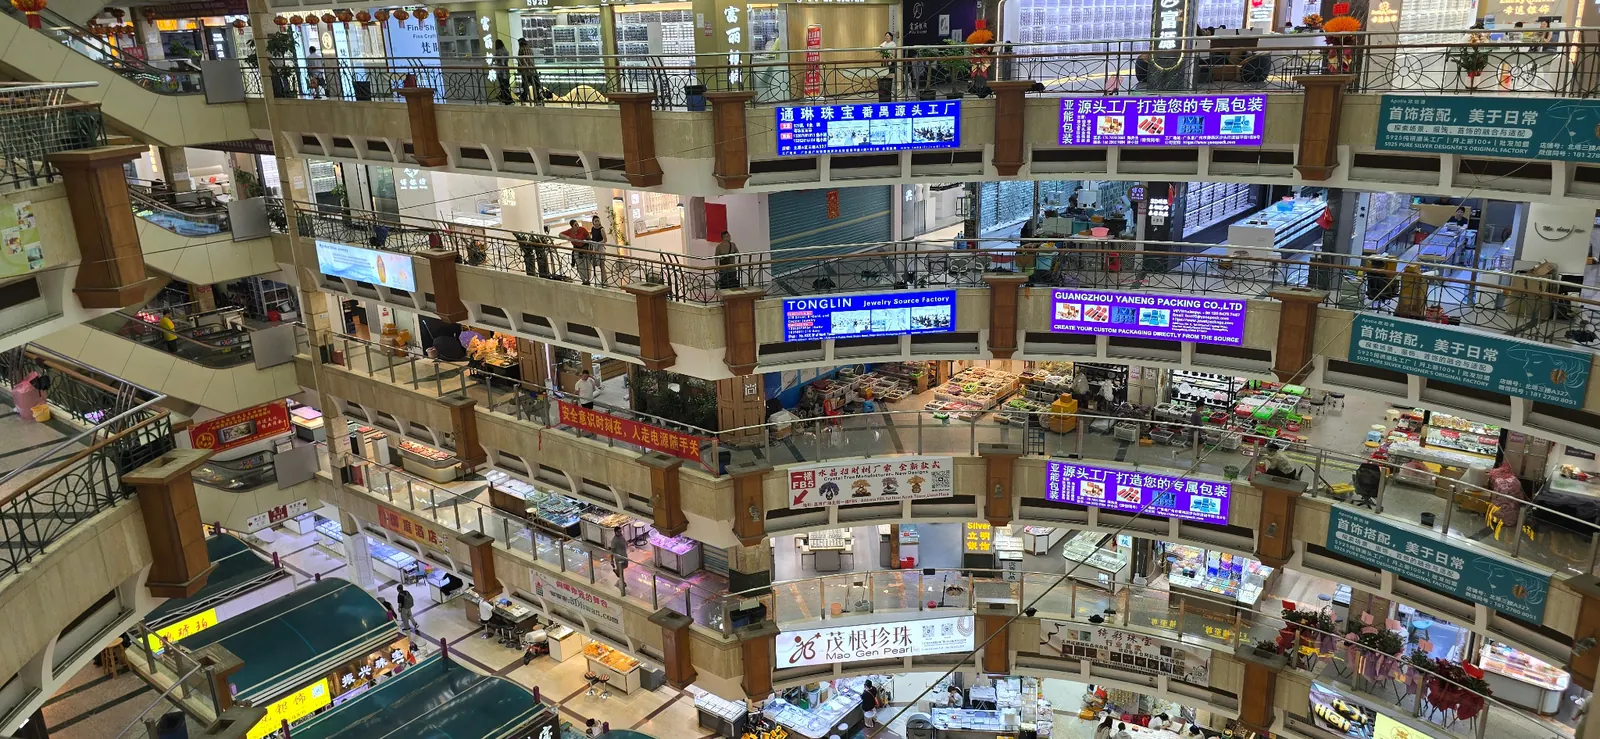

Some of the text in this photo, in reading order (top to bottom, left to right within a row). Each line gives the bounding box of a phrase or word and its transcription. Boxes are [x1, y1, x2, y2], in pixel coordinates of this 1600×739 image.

[780, 102, 955, 122] 通琳珠宝番禺源头工厂
[1077, 97, 1263, 115] 源头工厂打造您的专属包装
[1062, 100, 1074, 145] 亚能包装
[1389, 107, 1539, 126] 首饰搭配，美于日常
[788, 298, 852, 310] TONGLIN
[864, 300, 890, 308] Jewelry
[922, 296, 950, 304] Factory
[1055, 292, 1242, 311] GUANGZHOU YANENG PACKING CO.,LTD
[1360, 324, 1498, 362] 首饰搭配，美于日常
[1434, 371, 1462, 381] ORIGINAL
[1462, 377, 1489, 387] FACTORY
[1560, 398, 1577, 406] 8051
[562, 405, 699, 457] 安全意识时刻在，人走电源随手关
[899, 460, 941, 471] 全新款式
[792, 481, 814, 489] FB5
[794, 471, 813, 481] 一楼
[1049, 464, 1060, 500] 亚能包装
[1063, 465, 1228, 498] 源头工厂打造您的专属包装
[968, 522, 991, 530] Silver
[966, 532, 991, 540] 立明
[1338, 518, 1465, 570] 首饰搭配，美于日常
[966, 542, 991, 551] 银饰
[1406, 570, 1432, 583] ORIGINAL
[1432, 580, 1457, 592] FACTORY
[826, 625, 913, 652] 茂根珍珠
[855, 650, 879, 658] Gen
[883, 647, 914, 656] Pearl
[342, 650, 404, 688] 振兴珠宝
